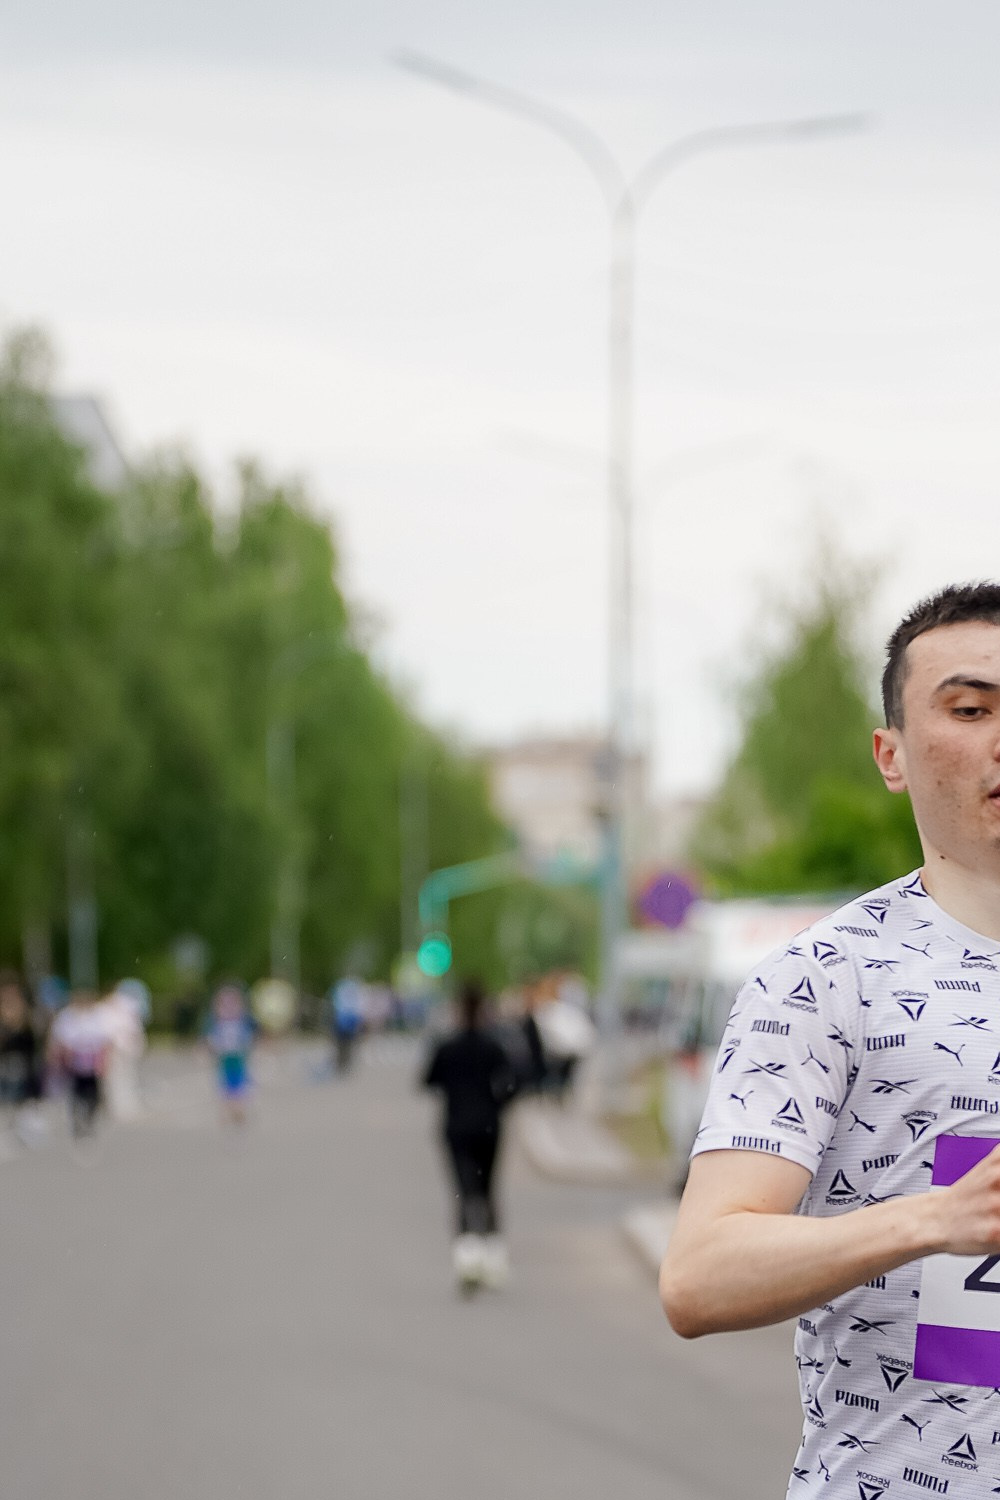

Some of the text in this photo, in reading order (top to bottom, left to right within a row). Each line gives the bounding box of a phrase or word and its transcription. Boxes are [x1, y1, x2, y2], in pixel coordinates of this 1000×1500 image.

[933, 979, 982, 993] PUMA
[951, 1095, 999, 1115] PUMA
[876, 1353, 913, 1370] Reebok
[835, 1389, 880, 1413] PUMA
[941, 1454, 979, 1473] Reebok
[856, 1470, 891, 1489] Reebok
[903, 1467, 949, 1494] PUMA
